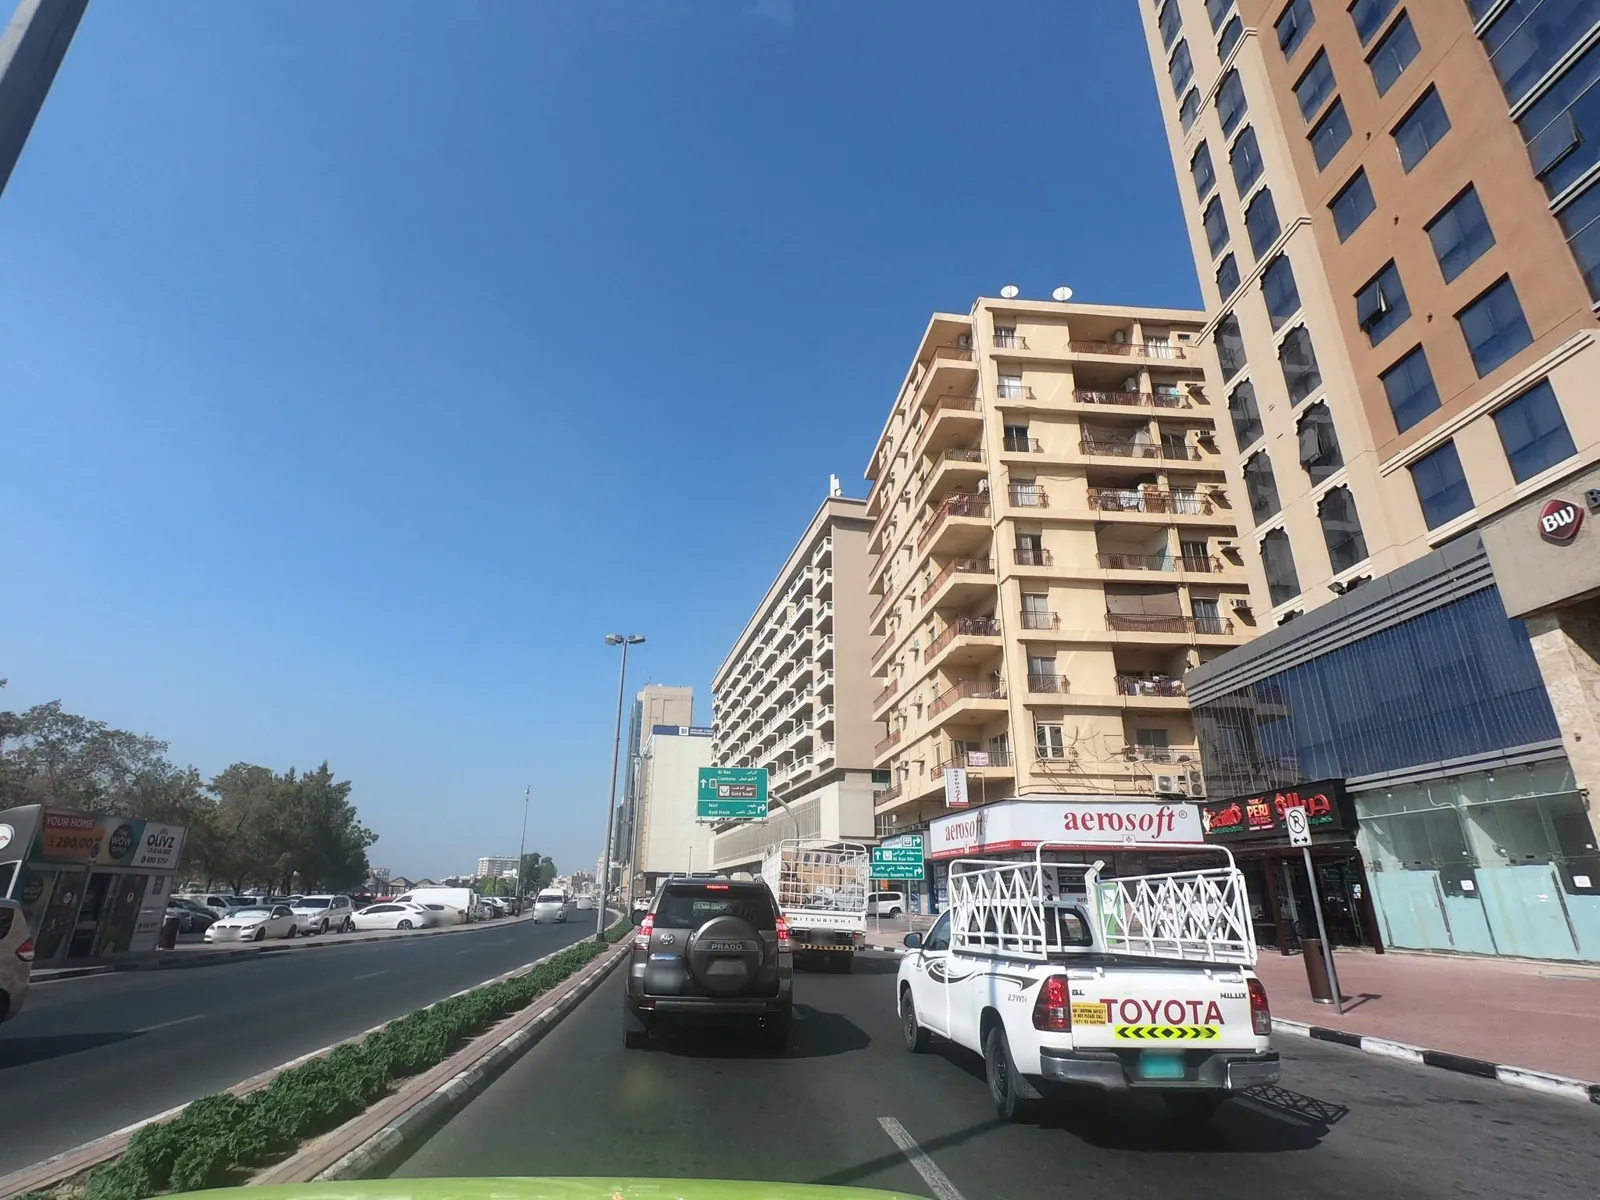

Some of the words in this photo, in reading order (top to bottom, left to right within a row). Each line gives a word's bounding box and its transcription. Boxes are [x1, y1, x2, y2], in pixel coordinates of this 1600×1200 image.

[1542, 506, 1575, 533] BW
[1246, 804, 1270, 818] PERI
[46, 816, 70, 826] YOUR
[70, 818, 94, 828] HOME
[945, 811, 983, 843] aerosoft
[1063, 805, 1175, 839] aerosoft
[110, 836, 132, 846] WOW
[147, 834, 176, 848] OLIVZ
[1099, 998, 1225, 1025] TOYOTA
